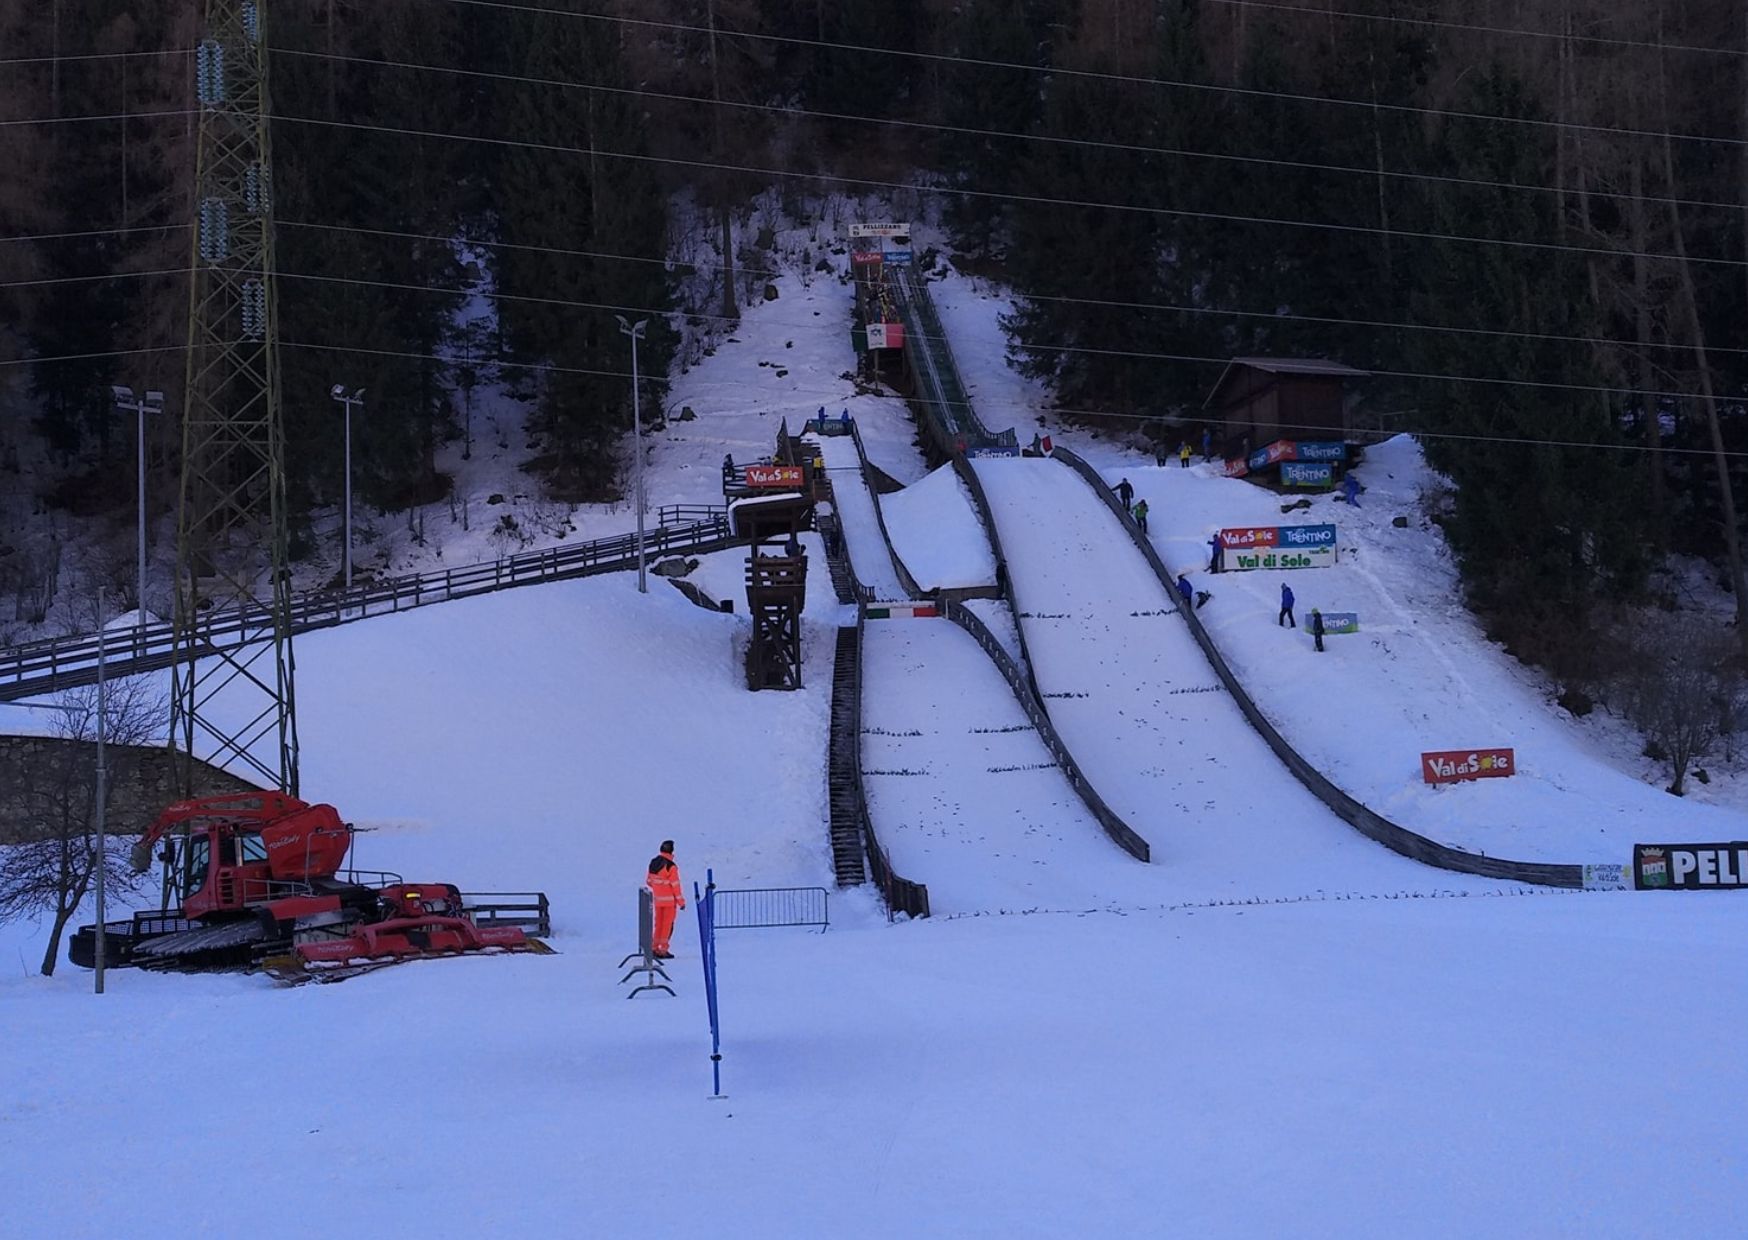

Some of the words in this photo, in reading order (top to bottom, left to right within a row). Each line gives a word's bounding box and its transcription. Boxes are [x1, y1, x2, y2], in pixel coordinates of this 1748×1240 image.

[1302, 445, 1341, 458] TRENTINO
[750, 470, 767, 483] Val
[1285, 465, 1330, 480] TRENTINO
[1222, 532, 1240, 545] Val
[1285, 528, 1332, 543] TRENTINO
[1237, 554, 1259, 568] Val
[1263, 553, 1277, 567] di
[1281, 553, 1312, 567] Sole
[1428, 758, 1456, 778] Val
[1457, 762, 1469, 774] di
